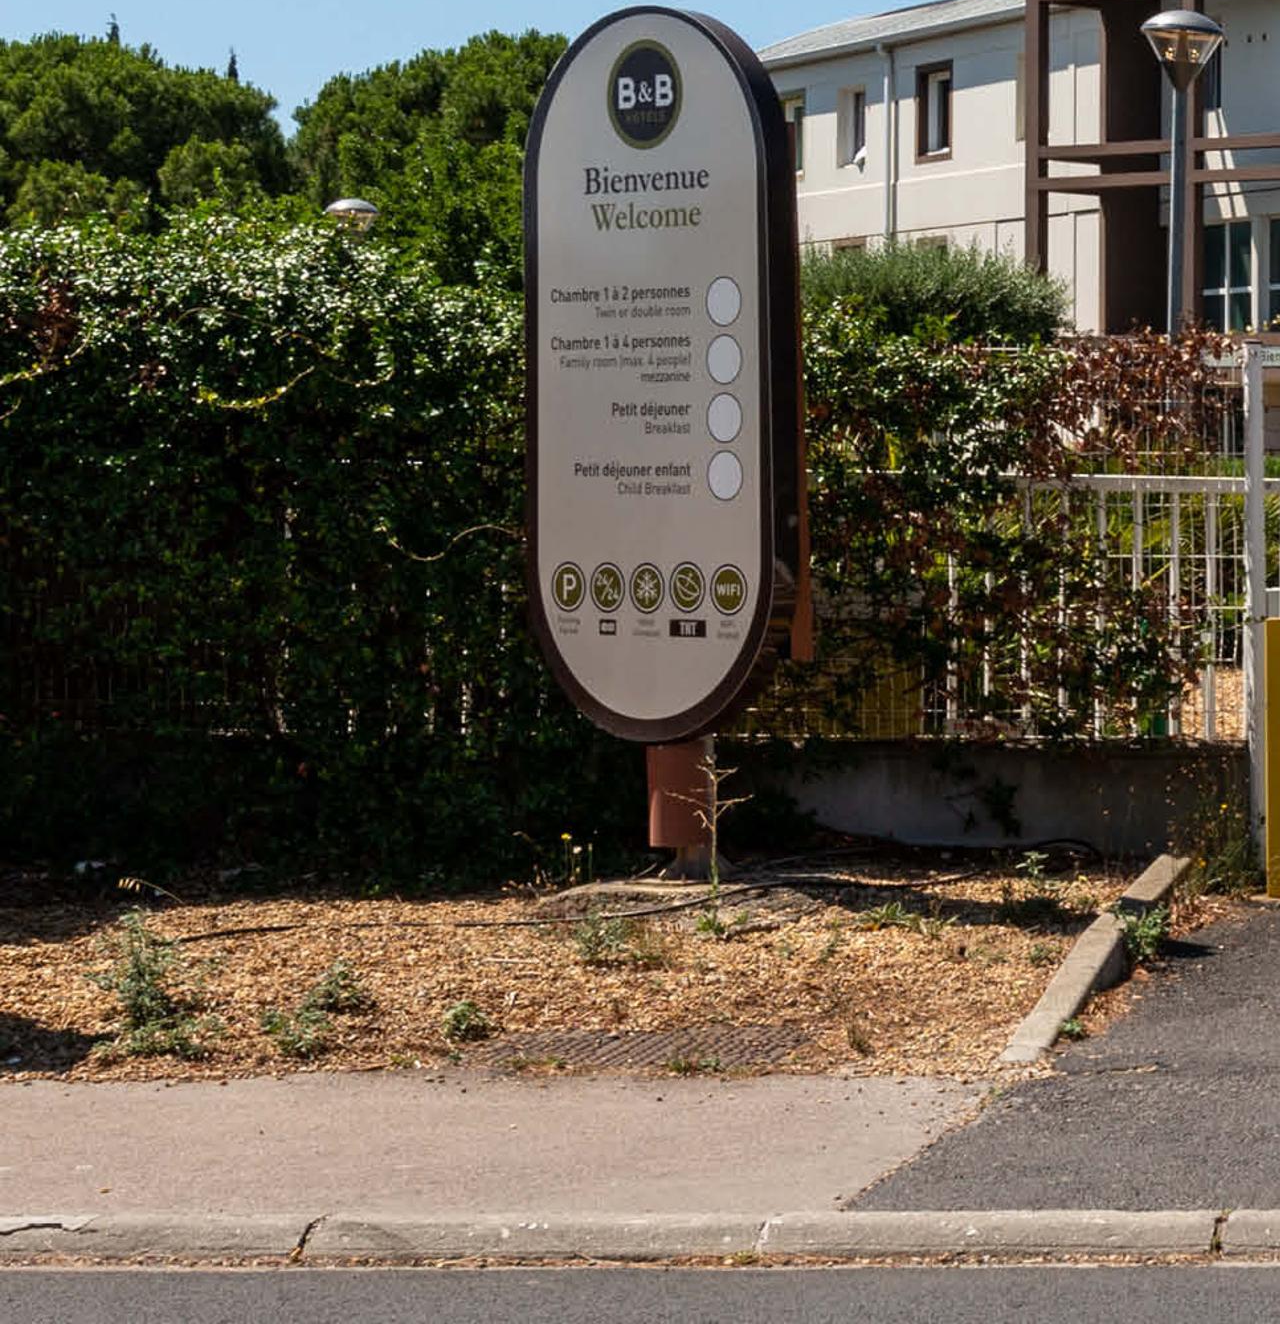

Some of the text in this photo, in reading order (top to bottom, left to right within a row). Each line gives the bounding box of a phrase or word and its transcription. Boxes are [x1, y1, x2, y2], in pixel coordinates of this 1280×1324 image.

[618, 73, 674, 110] B&B
[583, 166, 710, 196] Bienvenue
[592, 202, 701, 231] Welcome
[551, 285, 691, 304] Chambre 1 à 2 personnes
[551, 336, 601, 351] Chambre
[604, 335, 609, 349] 1
[622, 334, 629, 349] 4
[632, 336, 691, 352] personnes
[612, 402, 692, 420] Petit déjeuner
[645, 420, 691, 435] Breakfast
[574, 460, 691, 480] Petit déjeuner enfant
[562, 574, 577, 601] P
[716, 583, 741, 597] WIFI
